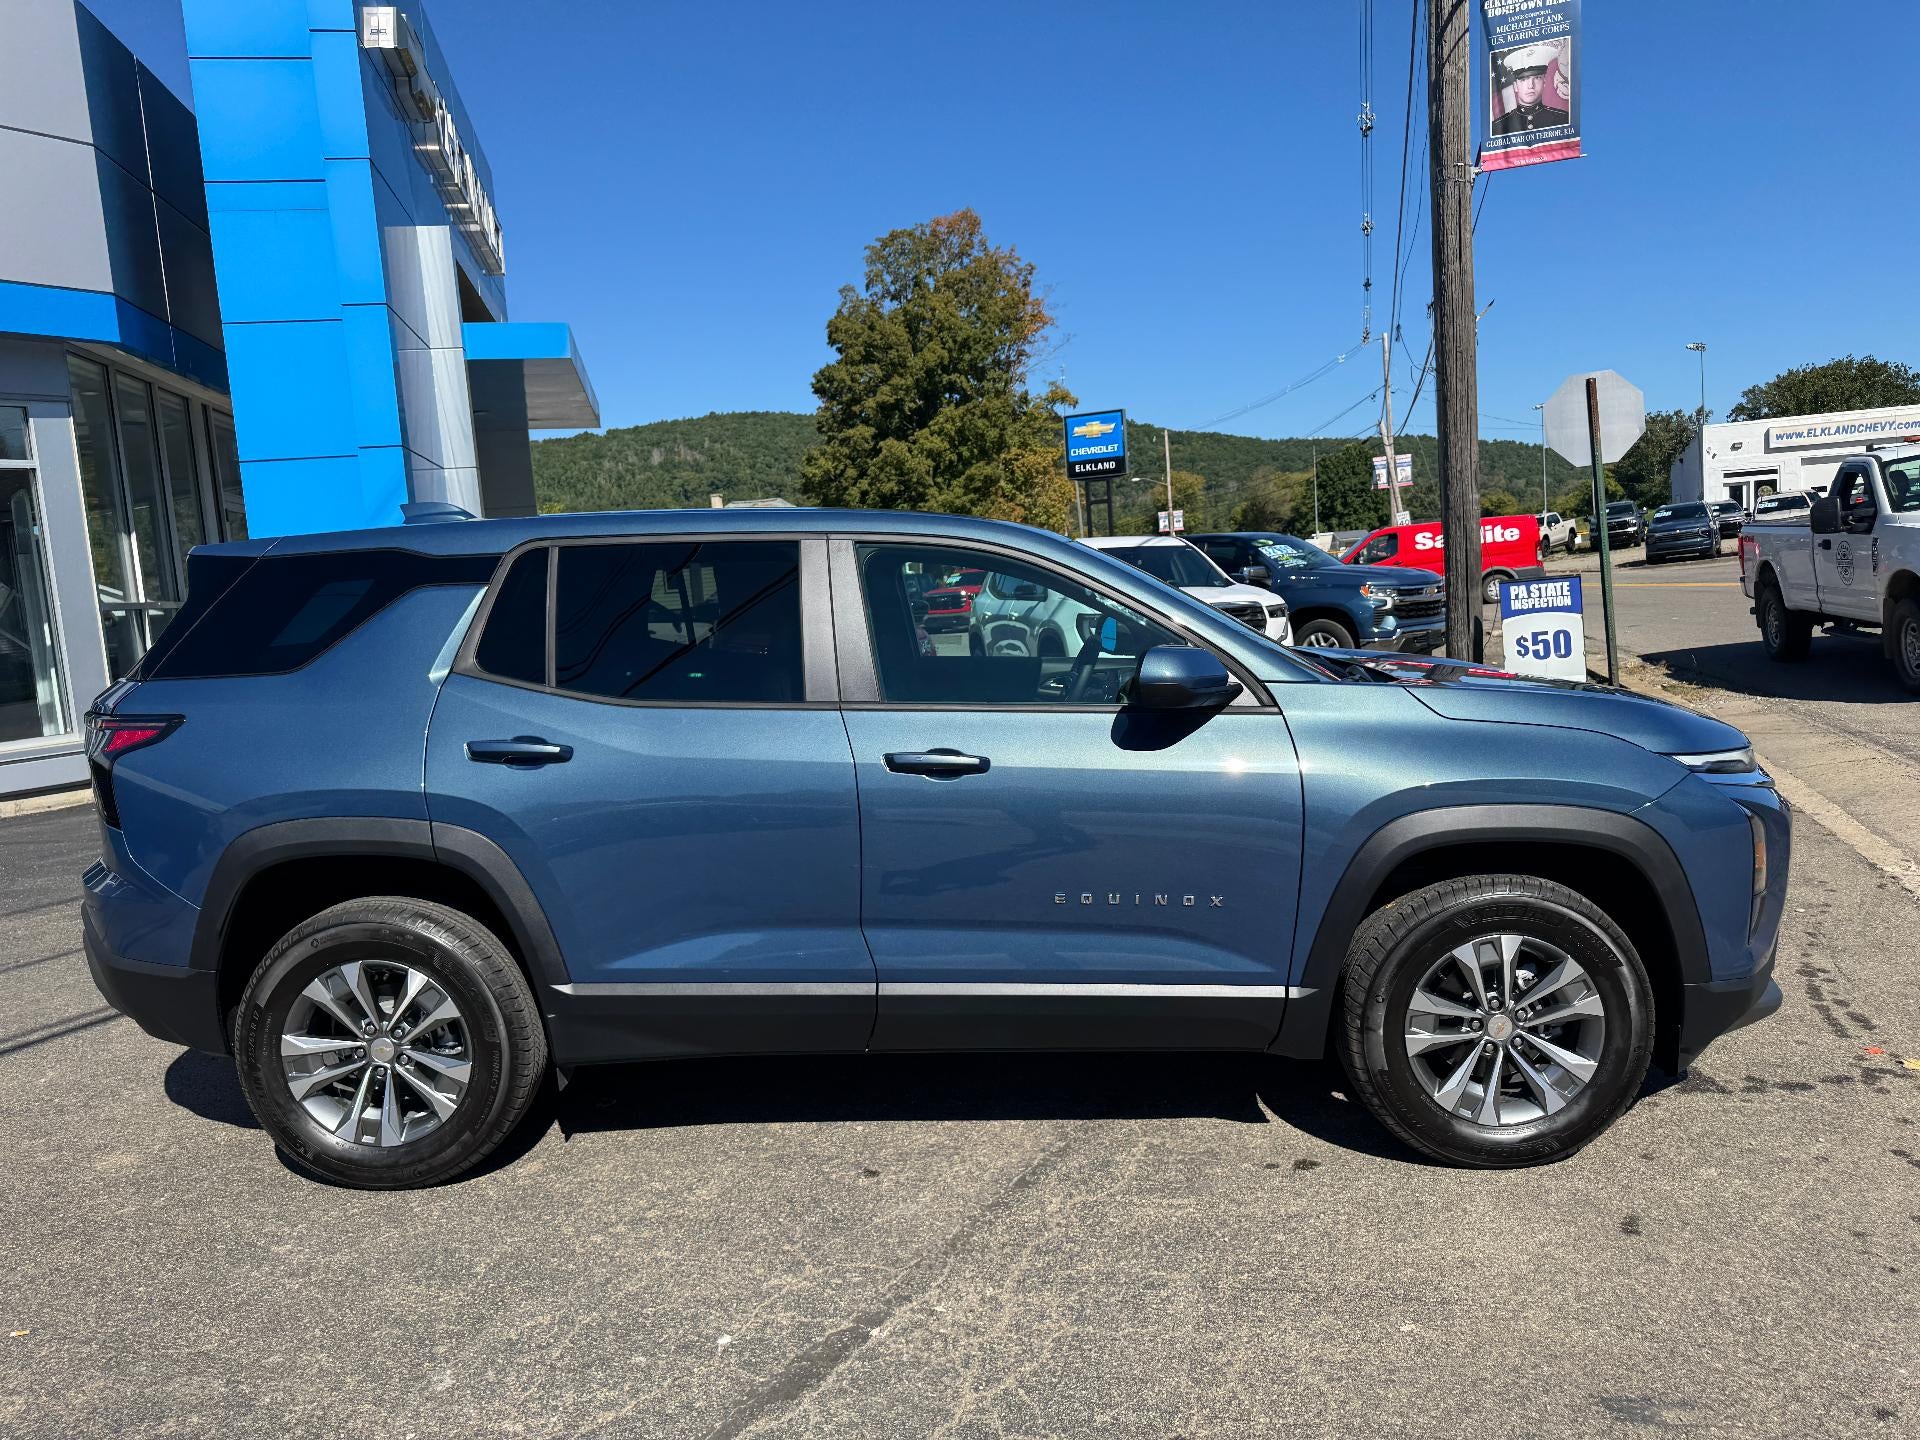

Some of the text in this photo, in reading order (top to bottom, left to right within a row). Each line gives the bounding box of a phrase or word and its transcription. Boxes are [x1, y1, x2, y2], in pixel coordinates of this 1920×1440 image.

[1488, 1, 1543, 17] HOMETOWN
[1496, 13, 1564, 34] MICHAEL PLANK
[1491, 23, 1570, 46] U.S. MARINE CORPS
[1486, 137, 1511, 148] GLOBAL
[1511, 135, 1525, 144] WAR
[1526, 134, 1535, 142] ON
[1071, 444, 1119, 456] CHEVROLET
[1075, 461, 1116, 472] ELKLAND
[1414, 524, 1520, 550] Salite
[1509, 581, 1570, 600] PA STATE
[1510, 595, 1571, 611] INSPECTION
[1515, 629, 1573, 661] $50
[1054, 892, 1224, 907] EQUINOX
